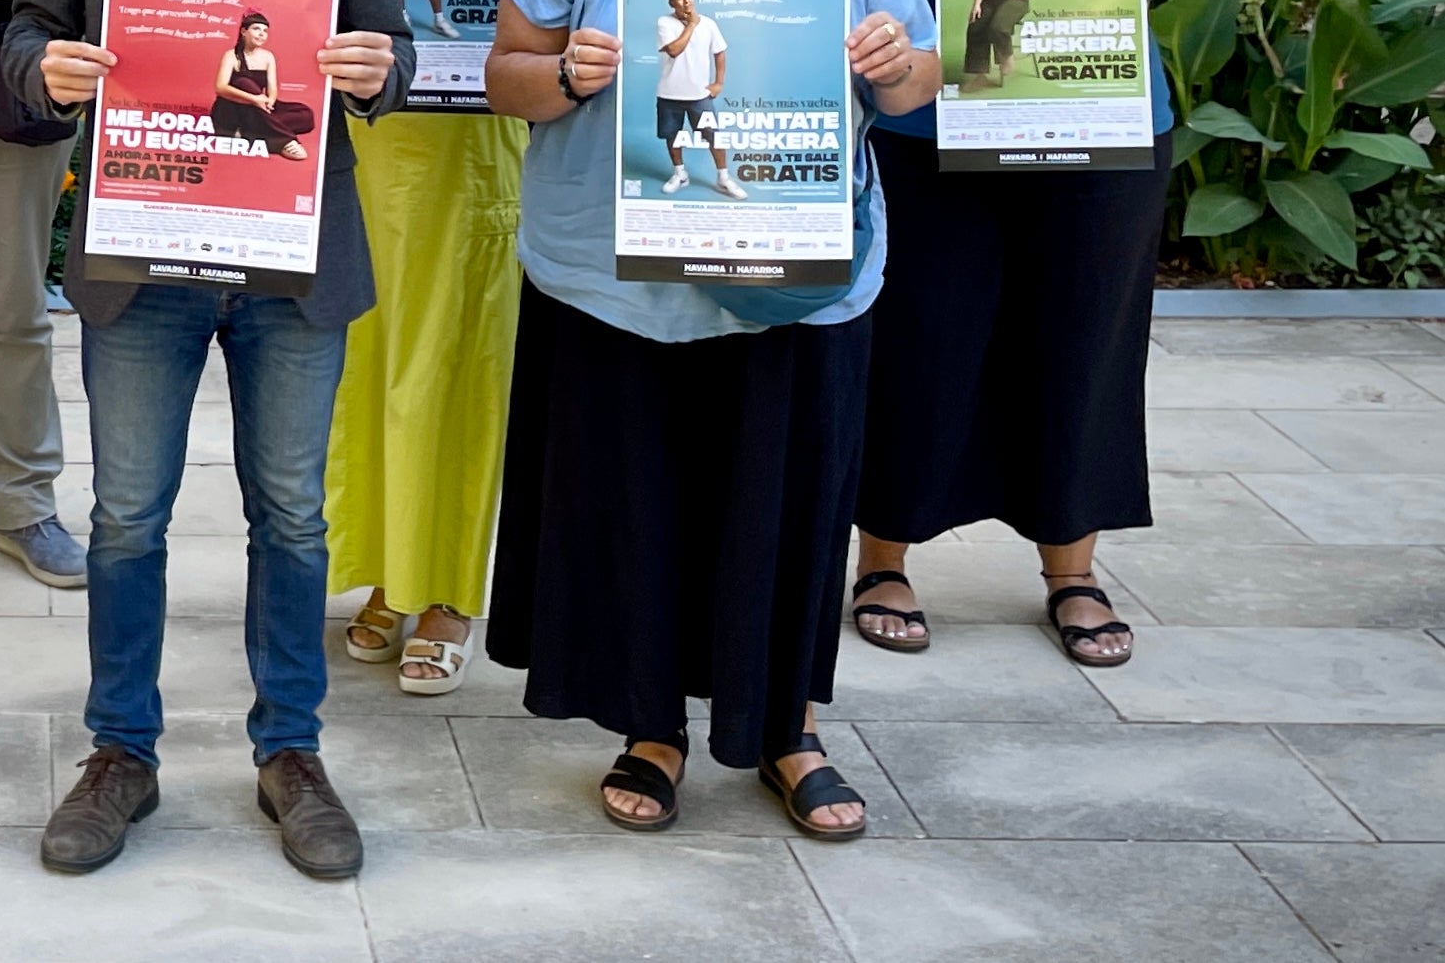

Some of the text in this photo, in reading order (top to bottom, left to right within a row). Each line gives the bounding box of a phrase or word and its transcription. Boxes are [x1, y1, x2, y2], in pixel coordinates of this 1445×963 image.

[451, 9, 498, 23] GRA
[1021, 18, 1135, 36] APRENDE
[1021, 36, 1136, 53] EUSKERA
[1038, 55, 1082, 63] AHORA
[1042, 64, 1137, 80] GRATIS
[106, 108, 215, 133] MEJORA
[697, 109, 839, 129] APÚNTATE
[105, 128, 269, 158] TU EUSKERA
[673, 131, 839, 149] AL EUSKERA
[105, 150, 208, 165] AHORA TE SALE
[733, 153, 839, 162] AHORA TE SALE
[103, 161, 204, 184] GRATIS
[737, 165, 839, 182] GRATIS
[150, 264, 246, 280] NAVARRA NAFARROA
[684, 264, 784, 274] NAVARRA NAFARROA
